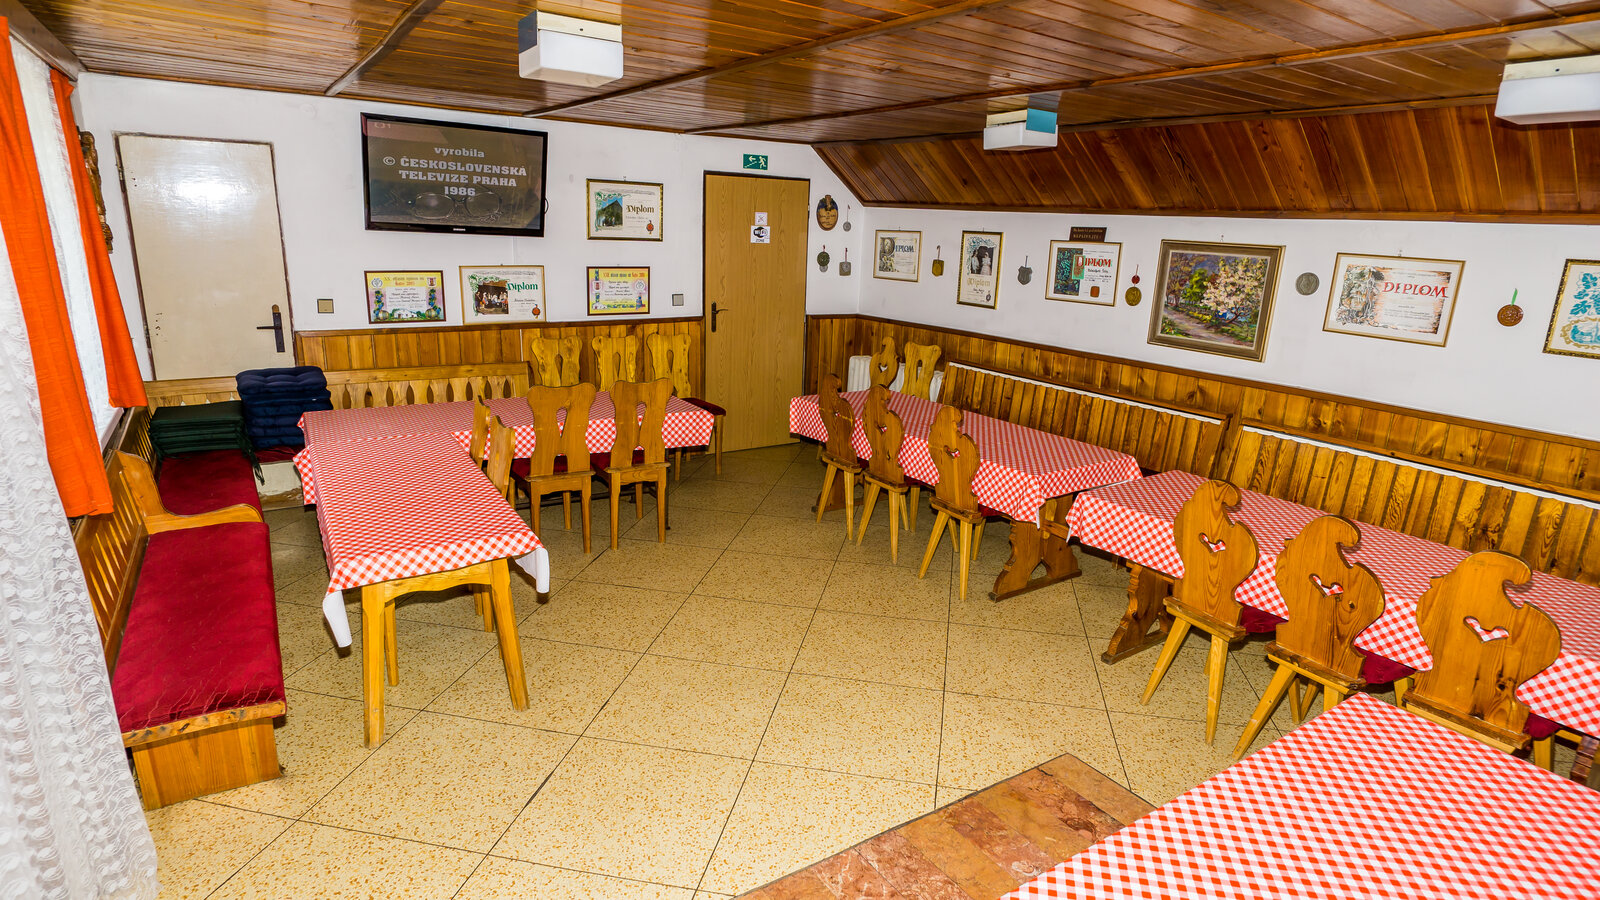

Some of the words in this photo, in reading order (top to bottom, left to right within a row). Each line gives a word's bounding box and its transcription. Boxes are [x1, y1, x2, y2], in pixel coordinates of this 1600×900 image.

[434, 147, 485, 158] vyrobila
[400, 155, 527, 176] ČESKOSLOVENSKÁ
[398, 170, 469, 184] TELEVIZE
[472, 176, 517, 187] PRAHA
[444, 186, 476, 197] 1986
[626, 204, 655, 215] Diplom
[1076, 255, 1111, 268] DIPLOM
[507, 281, 538, 293] Diplom
[1382, 281, 1449, 299] DIPLOM
